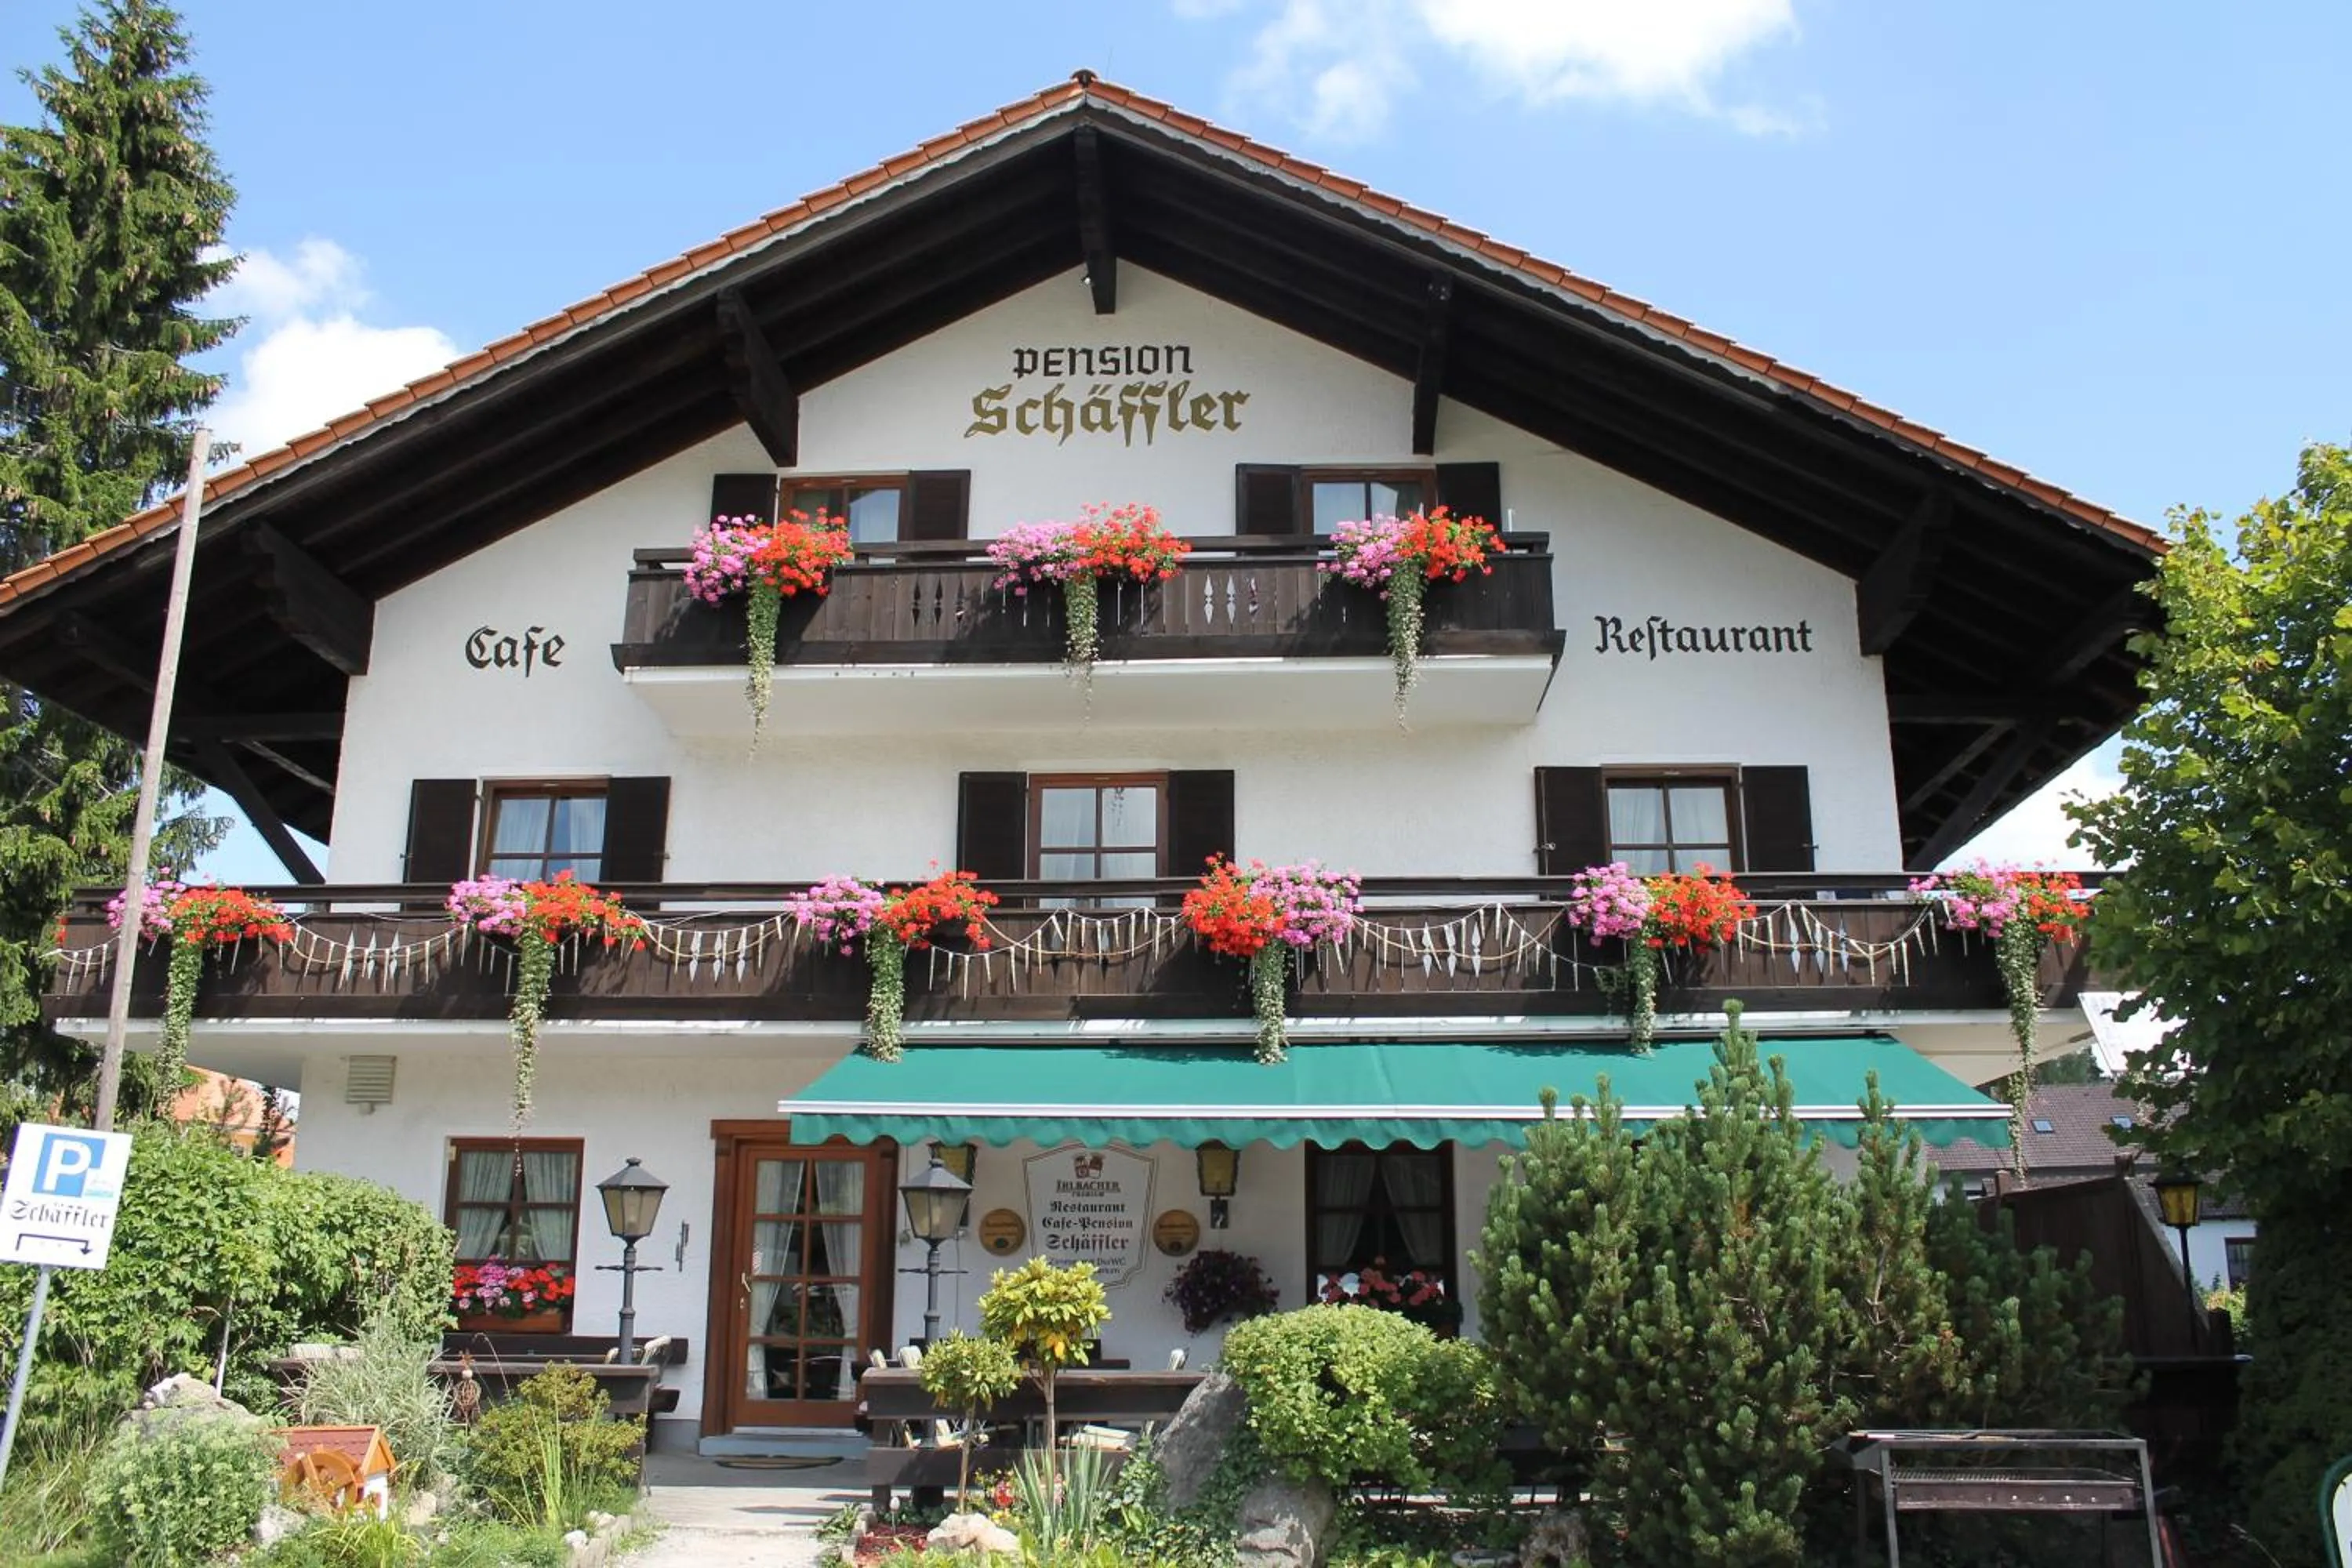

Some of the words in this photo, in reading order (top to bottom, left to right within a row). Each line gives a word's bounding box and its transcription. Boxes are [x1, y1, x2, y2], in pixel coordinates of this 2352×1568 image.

[964, 379, 1250, 448] Schäffler
[465, 625, 565, 678] Cafe
[42, 1138, 92, 1192] P
[10, 1199, 110, 1229] Schäffler
[1050, 1200, 1126, 1213] Restaurant
[1041, 1216, 1134, 1232] Cafe-Pension
[1045, 1232, 1130, 1254] Schäffler
